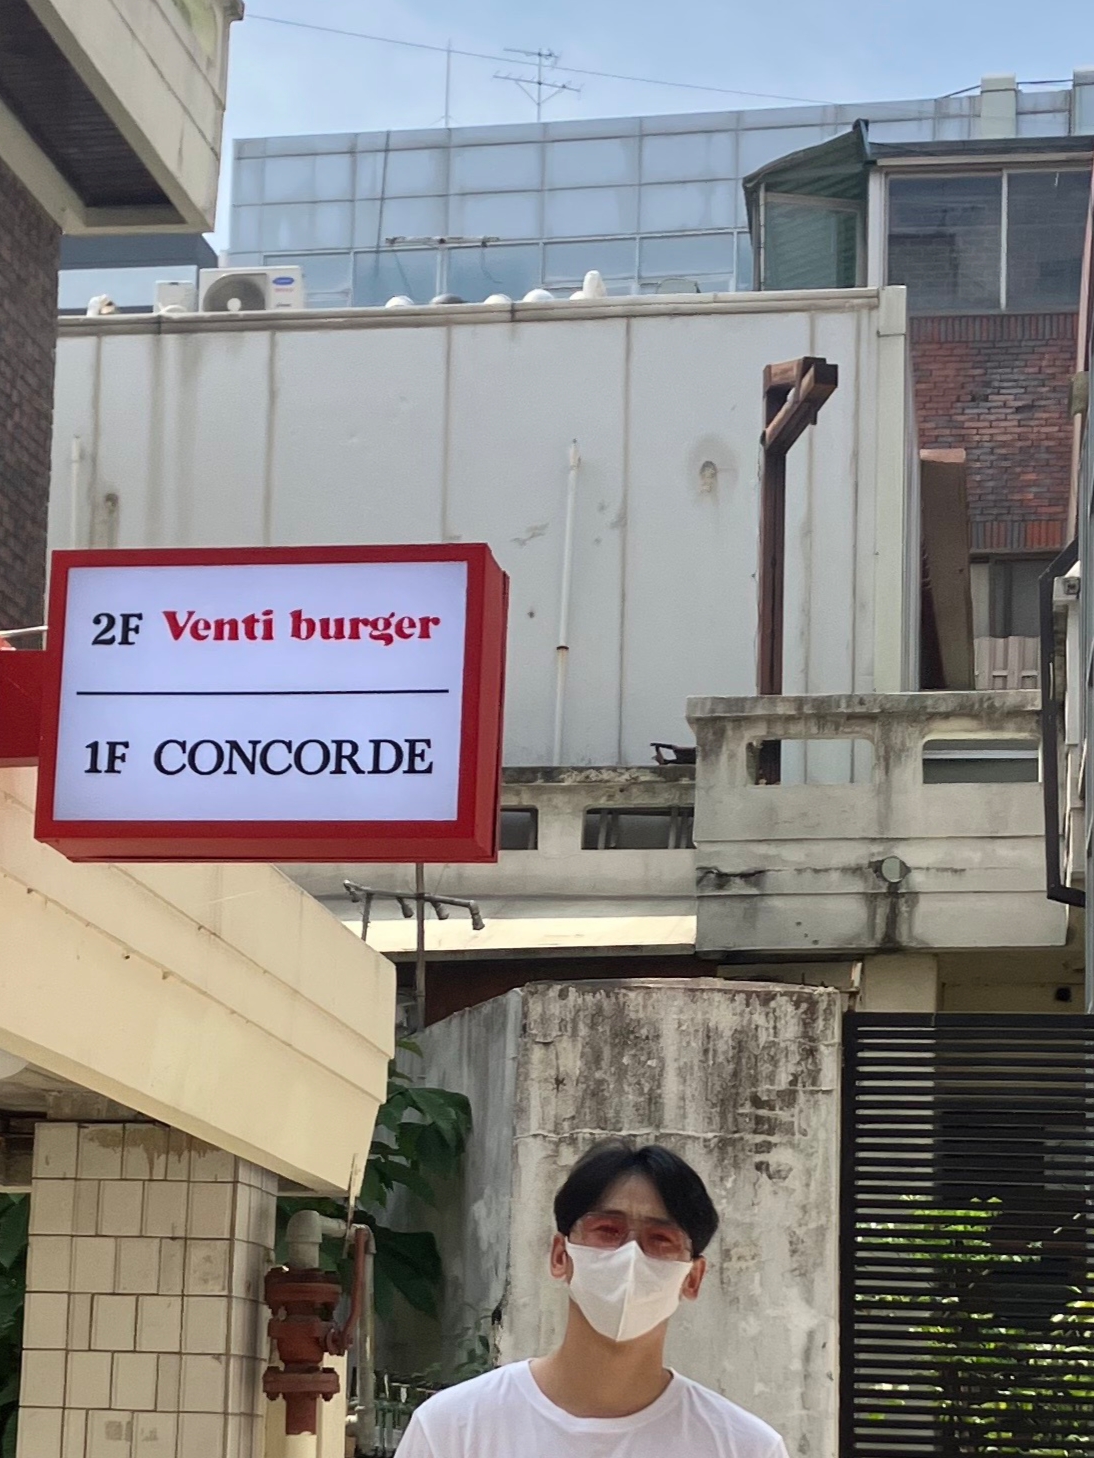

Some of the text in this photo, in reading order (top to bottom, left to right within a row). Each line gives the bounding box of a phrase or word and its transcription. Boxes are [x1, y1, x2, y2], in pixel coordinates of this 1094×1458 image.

[91, 608, 441, 647] 2F Venti burger
[83, 738, 434, 776] 1F CONCORDE
